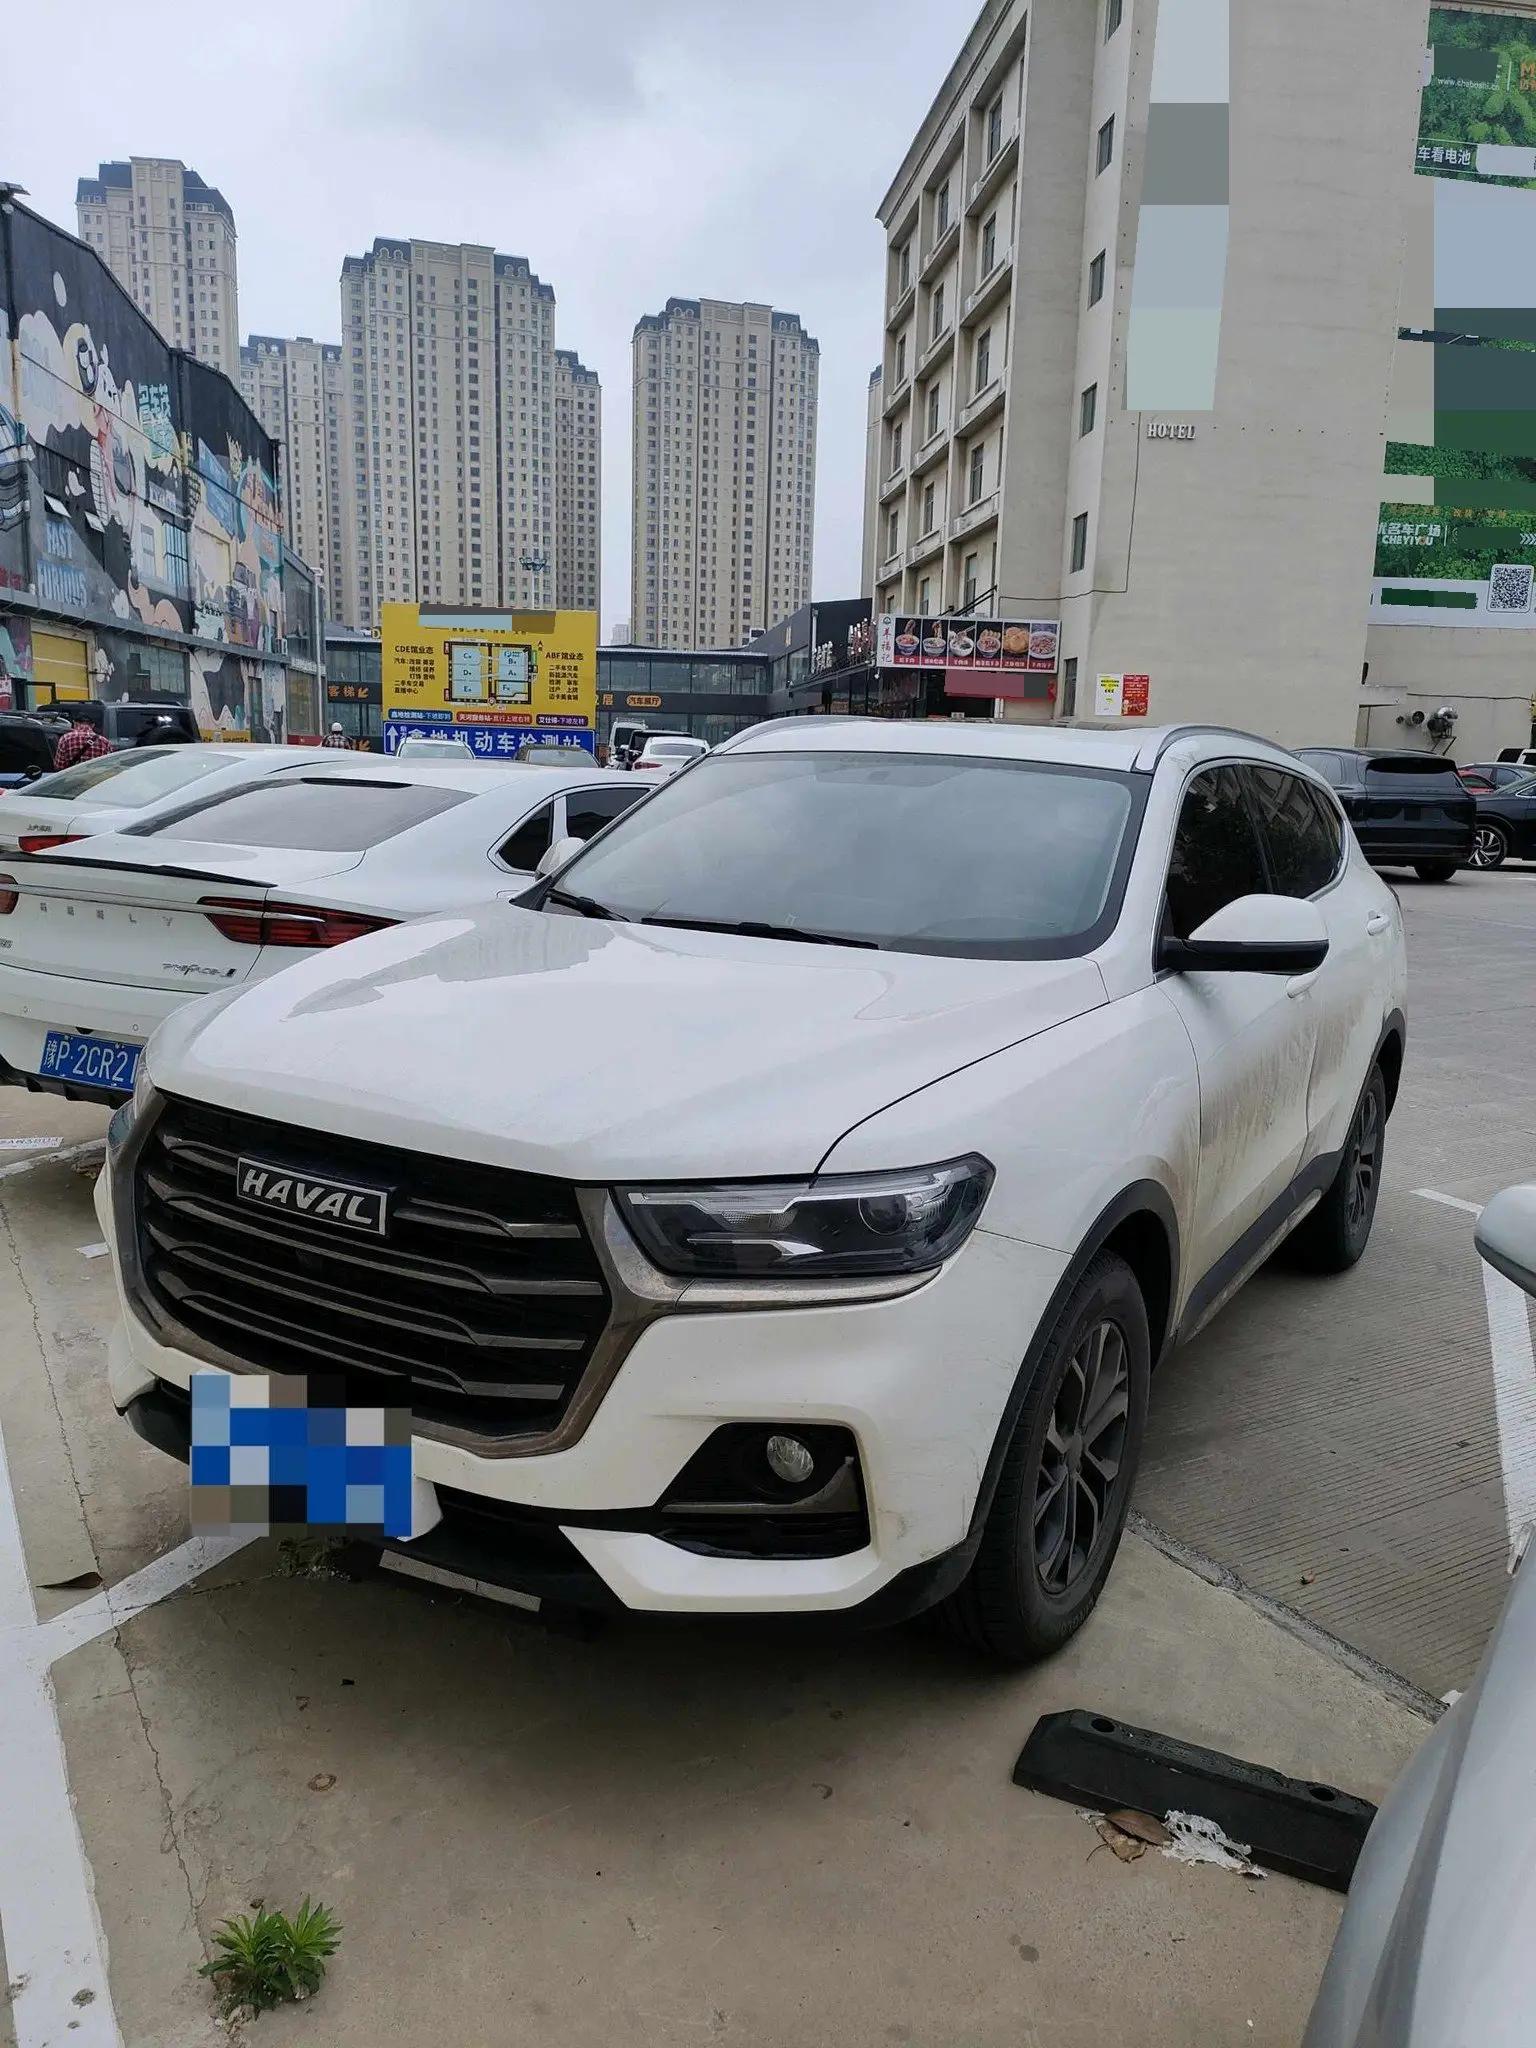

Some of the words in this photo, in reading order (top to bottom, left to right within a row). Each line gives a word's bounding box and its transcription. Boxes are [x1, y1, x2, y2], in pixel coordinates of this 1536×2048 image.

[1417, 146, 1471, 166] 车看电池
[1147, 423, 1196, 440] HOTEL
[46, 521, 73, 560] FAST
[628, 696, 660, 706] 汽车展厅
[242, 1168, 373, 1225] HAVAL
